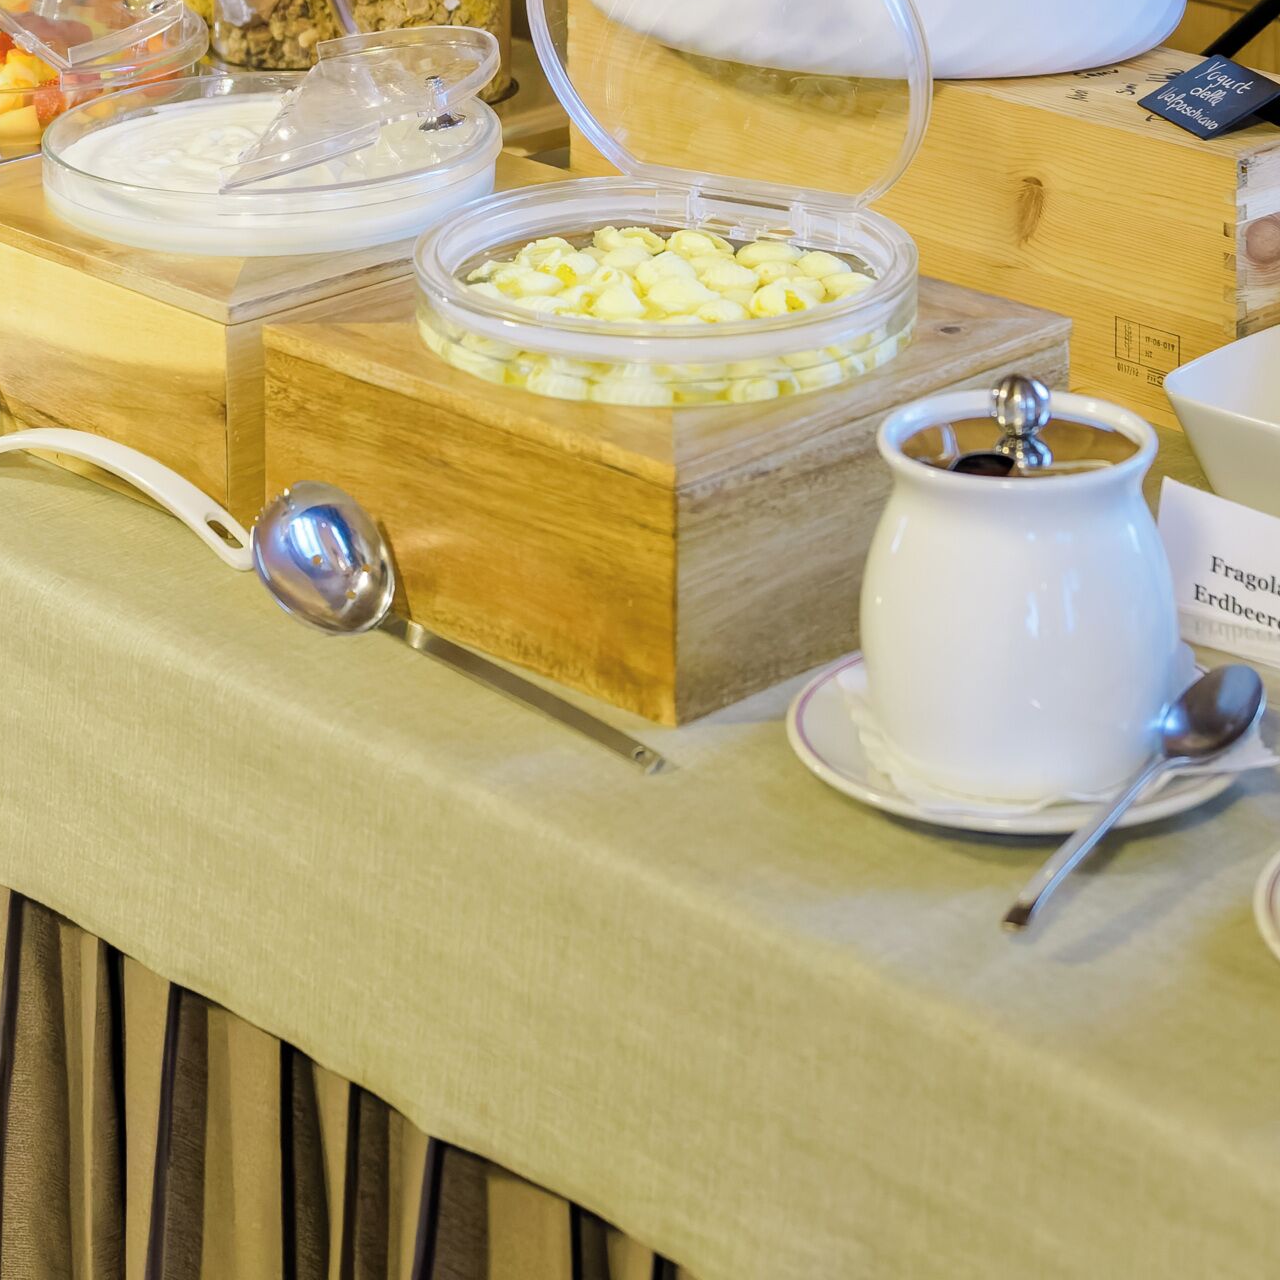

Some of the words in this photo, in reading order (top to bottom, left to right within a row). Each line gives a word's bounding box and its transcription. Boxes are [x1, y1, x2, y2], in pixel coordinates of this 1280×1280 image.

[1190, 83, 1227, 107] della
[1195, 61, 1255, 95] Yogurt
[1157, 87, 1220, 131] Valposchiavo
